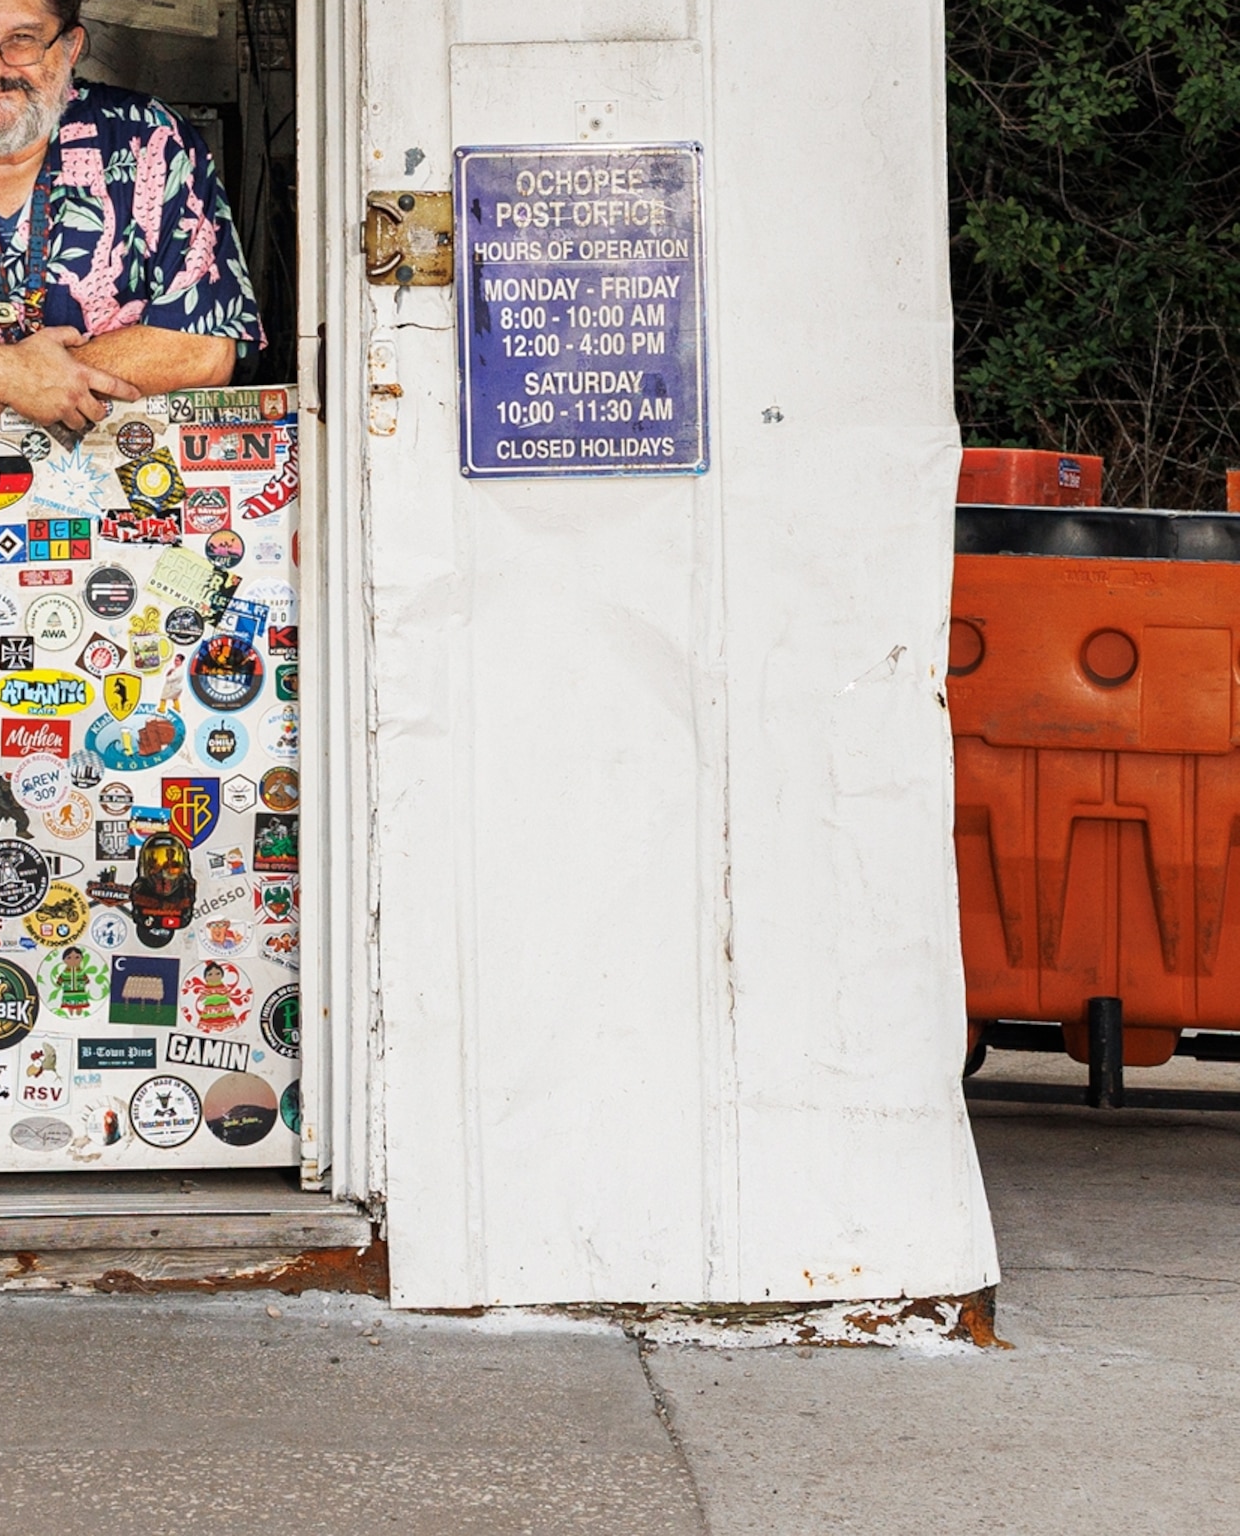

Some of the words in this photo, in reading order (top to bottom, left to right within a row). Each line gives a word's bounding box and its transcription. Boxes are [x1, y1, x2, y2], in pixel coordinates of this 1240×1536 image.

[516, 169, 644, 197] OCHOPEE
[496, 202, 566, 228] POST
[573, 199, 668, 227] OFFICE
[475, 240, 541, 262] HOURS
[548, 240, 573, 260] OF
[579, 239, 688, 260] OPERATION
[484, 277, 580, 302] MONDAY
[601, 275, 679, 299] FRIDAY
[500, 307, 545, 330] 8:00
[567, 305, 624, 327] 10:00
[630, 304, 665, 326] AM
[502, 334, 560, 357] 12:00
[579, 333, 625, 355] 4:00
[632, 332, 665, 354] PM
[525, 370, 644, 396] SATURDAY
[170, 397, 191, 418] 96
[223, 390, 261, 406] STADT
[496, 401, 553, 424] 10:00
[575, 400, 631, 422] 11:30
[638, 399, 672, 421] AM
[496, 439, 575, 460] CLOSED
[581, 438, 675, 459] HOLIDAYS
[41, 629, 67, 639] AWA
[5, 723, 63, 755] Mythen
[33, 786, 58, 802] 309
[192, 886, 245, 920] adesso
[128, 1046, 154, 1059] Pins
[169, 1035, 248, 1071] GAMIN
[23, 1085, 63, 1101] RSV
[133, 1103, 141, 1120] BEST
[138, 1086, 149, 1103] BEEF
[153, 1079, 173, 1088] MADE
[173, 1079, 182, 1088] IN
[181, 1084, 199, 1116] GERMANY
